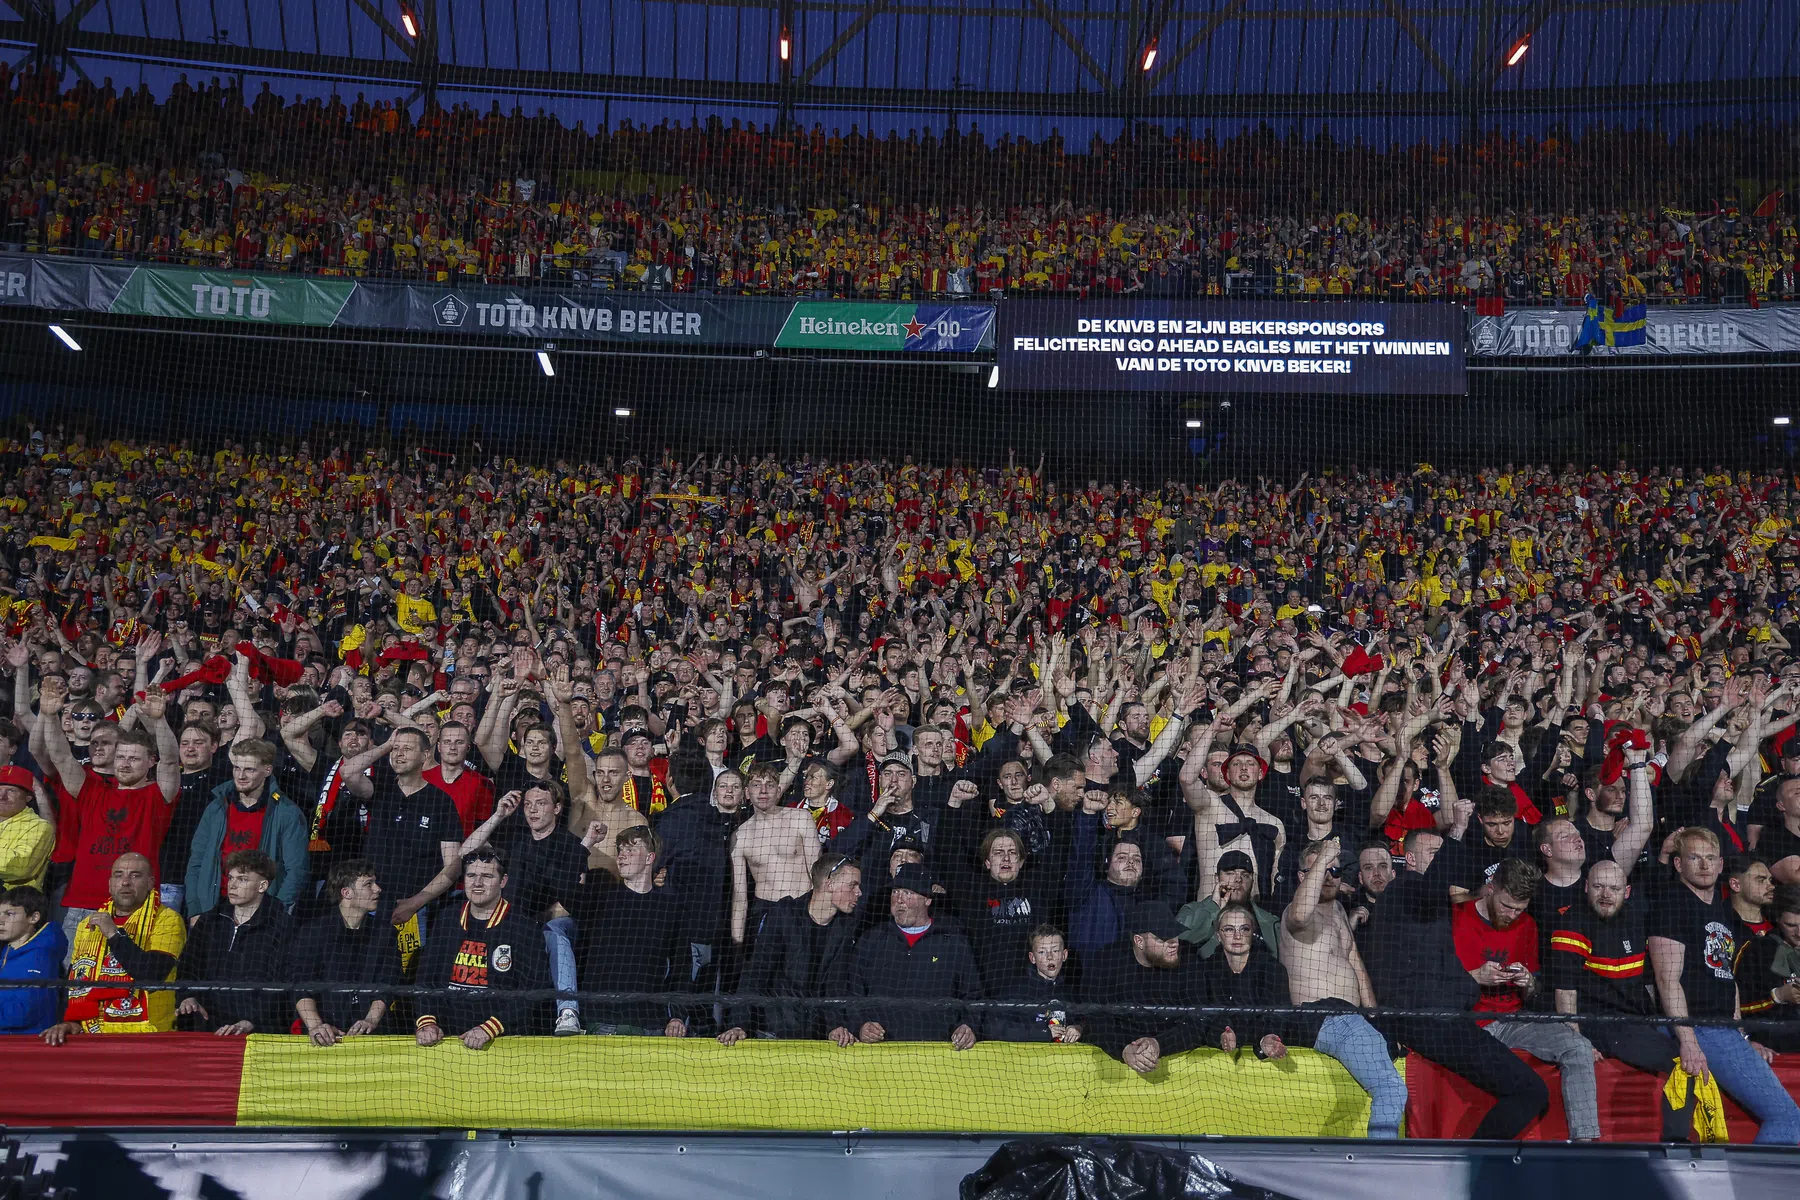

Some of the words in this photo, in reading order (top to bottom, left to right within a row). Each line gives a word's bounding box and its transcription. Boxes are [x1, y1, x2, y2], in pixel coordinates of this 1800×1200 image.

[192, 284, 270, 318] TOTO
[476, 302, 536, 328] TOTO
[542, 306, 613, 332] KNVB
[619, 309, 702, 336] BEKER
[799, 316, 899, 336] Heineken
[1078, 320, 1102, 333] DE
[1104, 320, 1156, 334] KNVB
[1158, 321, 1183, 334] EN
[1186, 321, 1226, 335] ZIJN
[1229, 321, 1385, 336] BEKERSPONSORS
[1511, 324, 1570, 347] TOTO
[1654, 323, 1740, 347] BEKER
[1013, 337, 1125, 352] FELICITEREN
[1128, 338, 1155, 352] GO
[1156, 338, 1220, 353] AHEAD
[1223, 339, 1291, 354] EAGLES
[1295, 340, 1333, 355] MET
[1336, 341, 1371, 355] HET
[1373, 341, 1450, 356] WINNEN
[1116, 357, 1155, 371] VAN
[1157, 358, 1182, 372] DE
[1184, 358, 1231, 372] TOTO
[1234, 358, 1286, 373] KNVB
[1288, 359, 1351, 374] BEKER!
